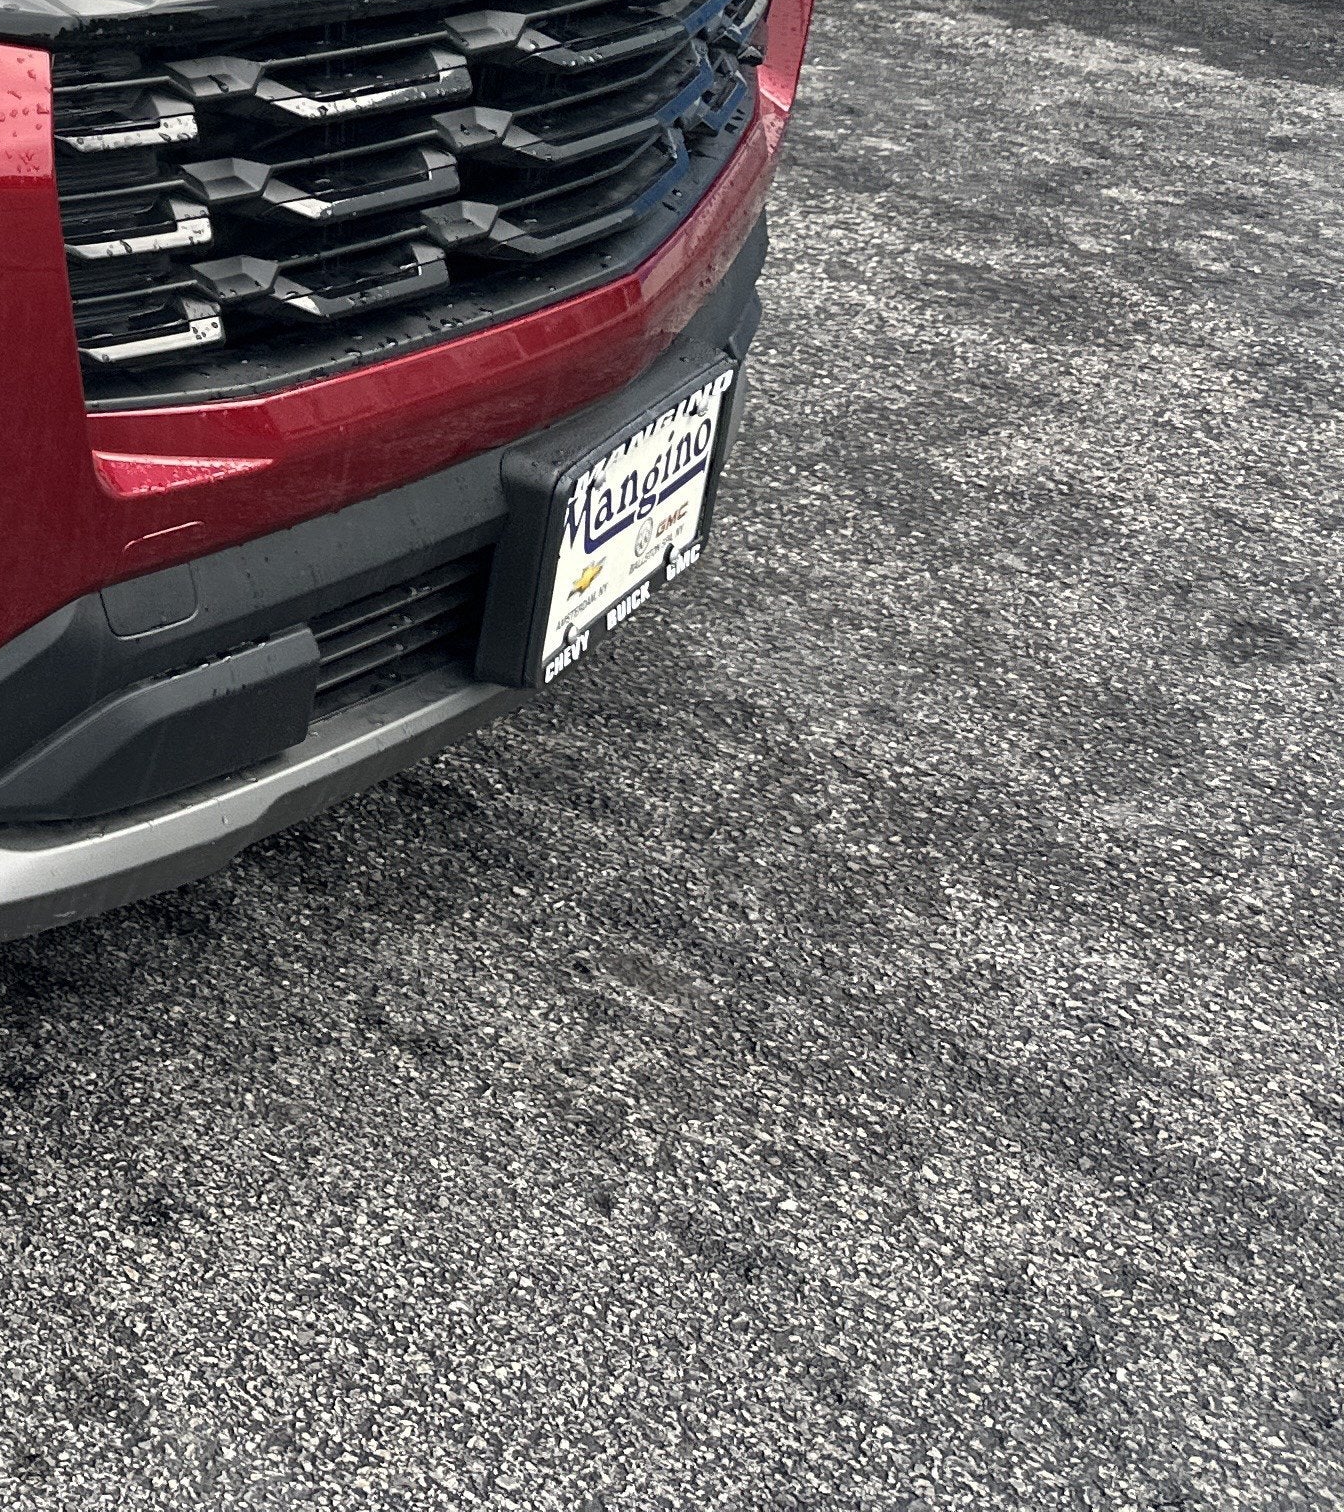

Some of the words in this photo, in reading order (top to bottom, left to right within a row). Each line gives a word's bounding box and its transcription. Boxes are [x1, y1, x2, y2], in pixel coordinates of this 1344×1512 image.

[566, 418, 712, 555] Mangino
[574, 369, 734, 493] MANGINO
[655, 500, 689, 538] GMC
[545, 630, 590, 684] CHEVY
[607, 581, 651, 631] BUICK
[666, 544, 700, 581] GMC
